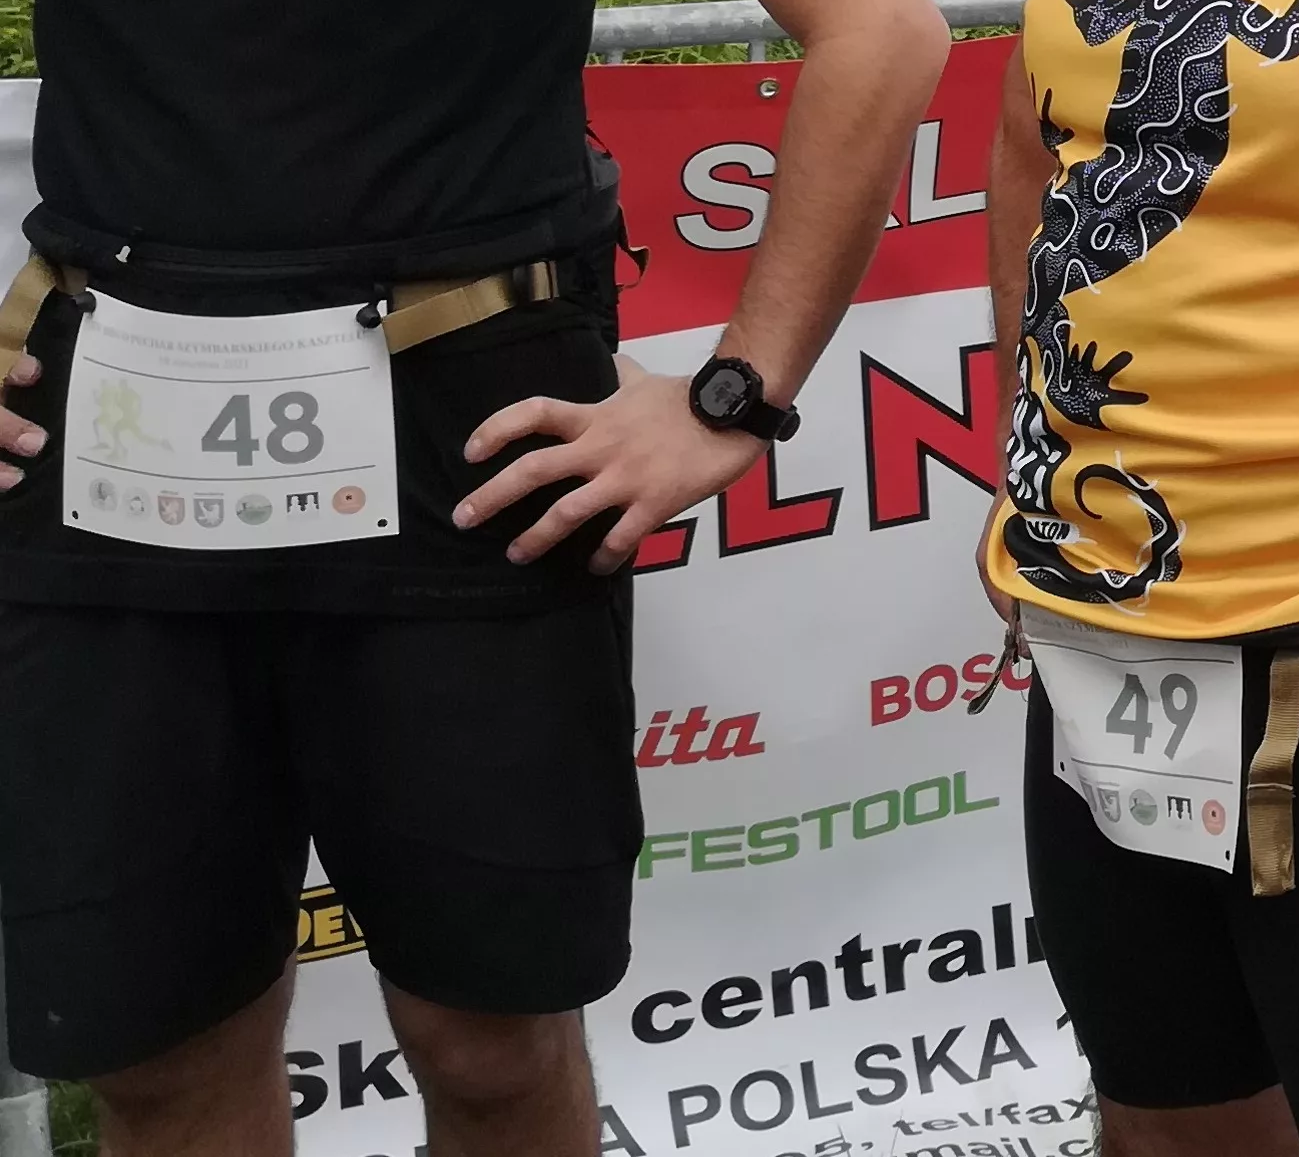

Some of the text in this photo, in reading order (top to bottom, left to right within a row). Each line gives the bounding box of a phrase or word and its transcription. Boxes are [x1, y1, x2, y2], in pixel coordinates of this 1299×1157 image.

[674, 118, 988, 252] SL
[201, 390, 325, 467] 48
[1105, 673, 1198, 760] 49
[637, 770, 1000, 880] FESTOOL
[668, 1017, 1038, 1149] POLSKA
